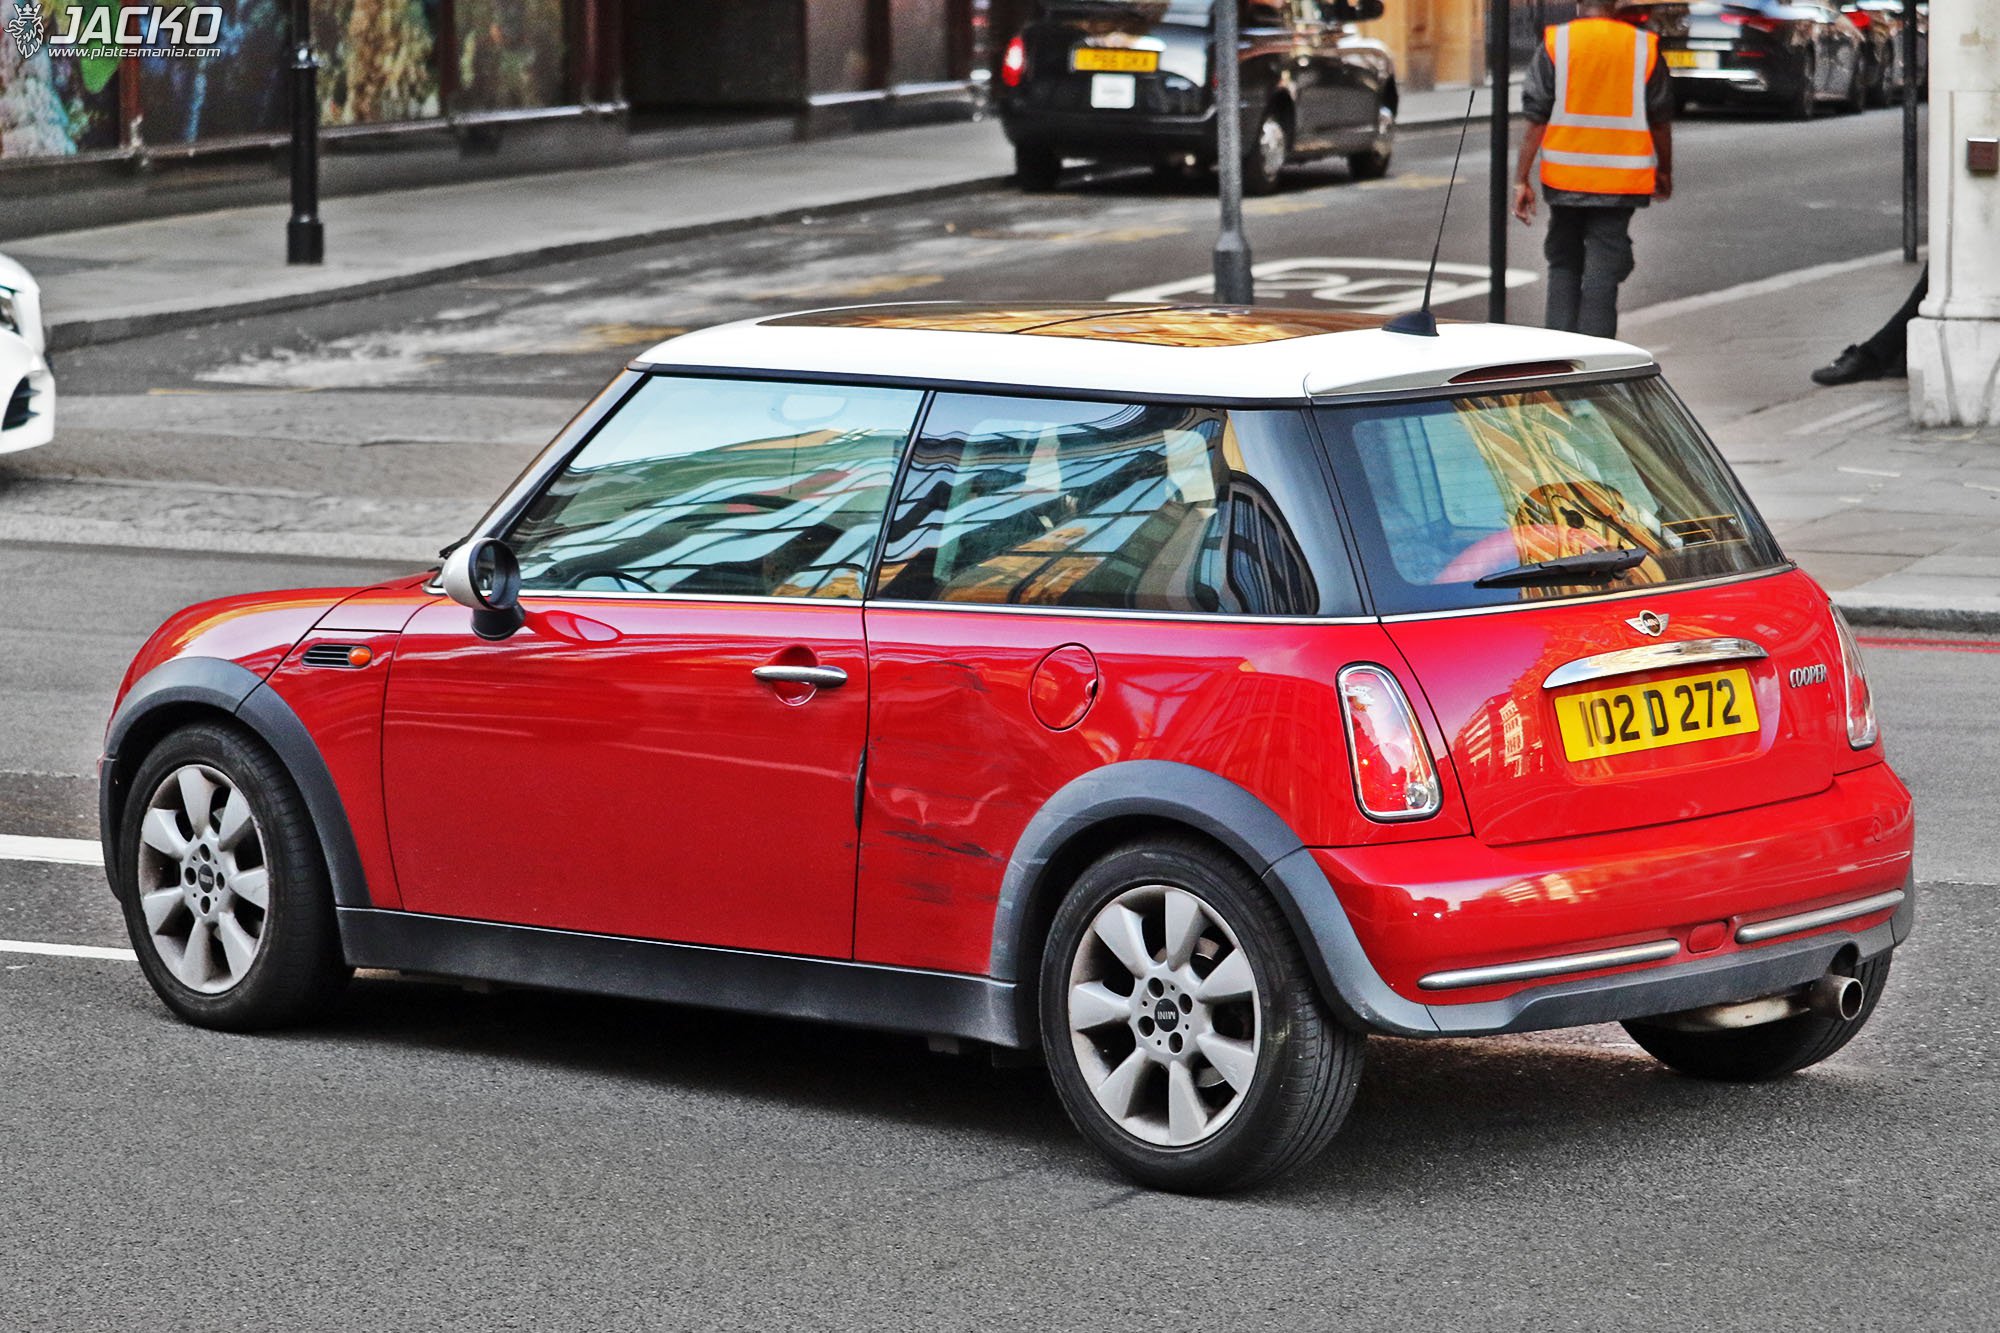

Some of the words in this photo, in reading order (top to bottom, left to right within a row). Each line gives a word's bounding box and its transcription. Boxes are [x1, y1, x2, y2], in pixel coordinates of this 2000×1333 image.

[1789, 663, 1827, 688] COOPER
[1578, 694, 1640, 748] 102
[1643, 689, 1670, 737] D
[1674, 678, 1741, 732] 272
[1157, 1010, 1176, 1020] MINI
